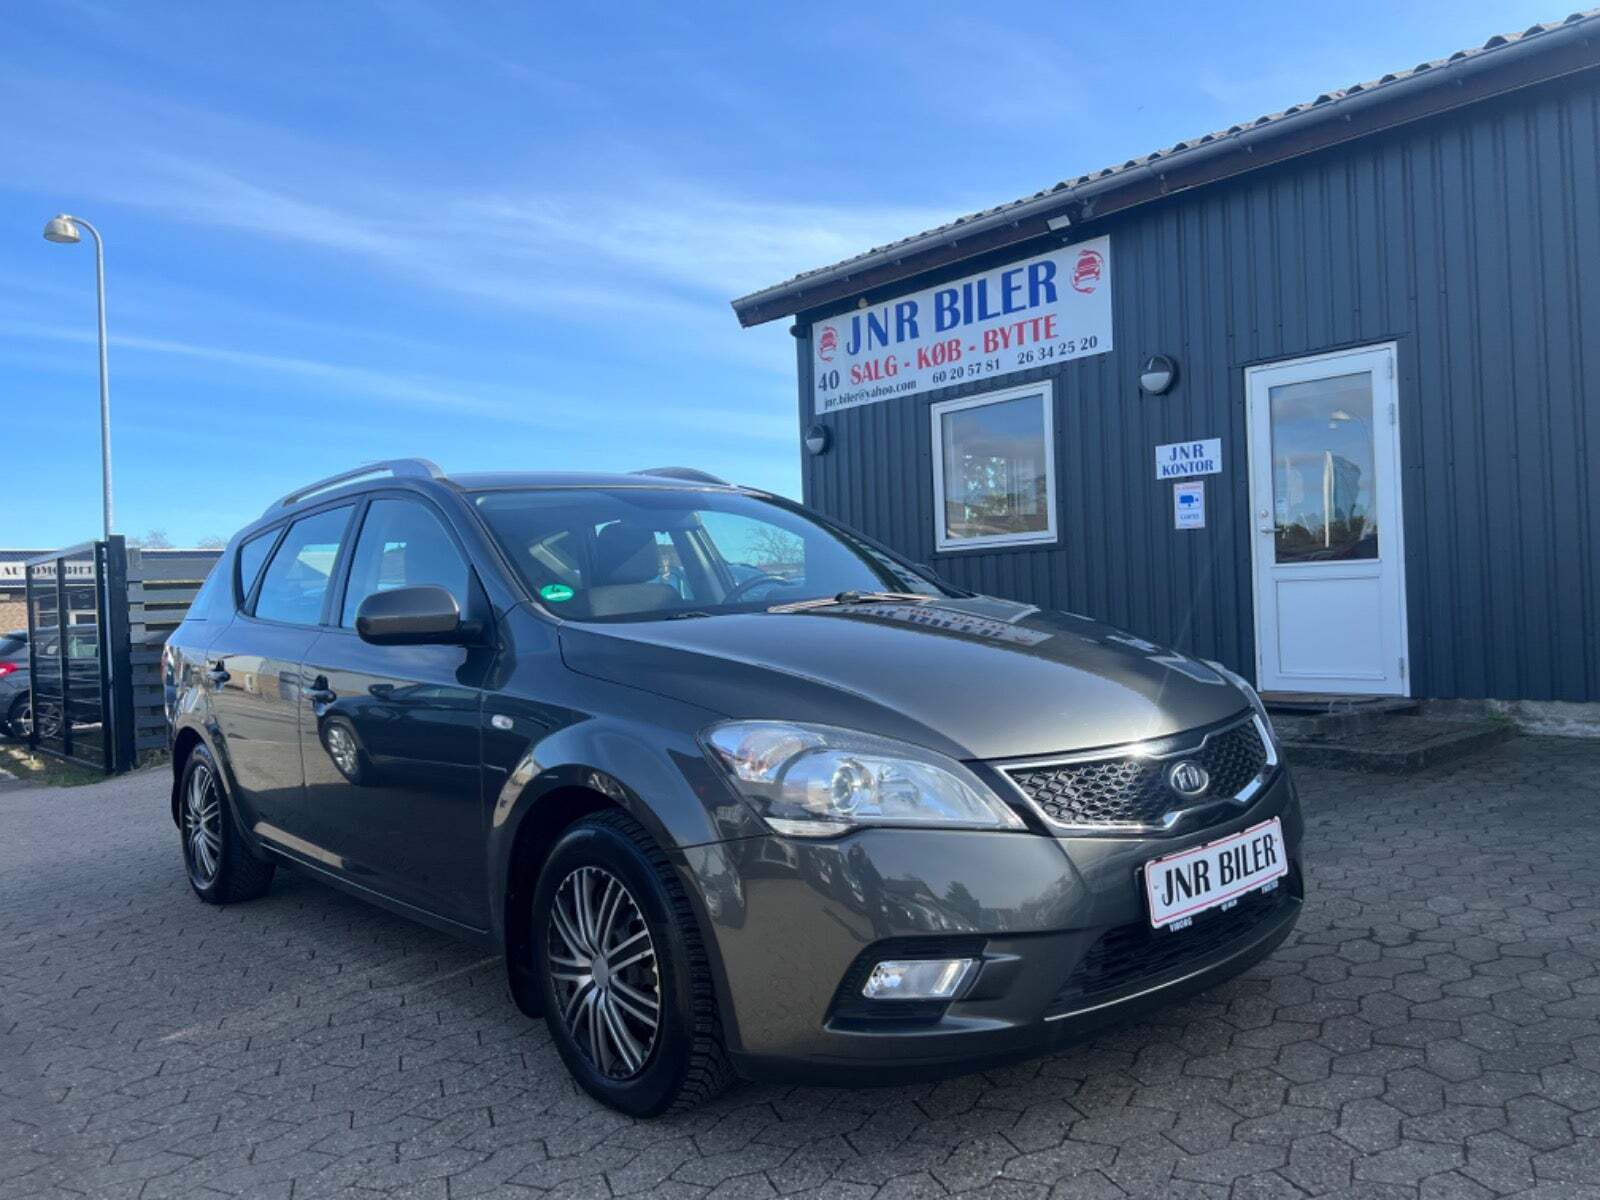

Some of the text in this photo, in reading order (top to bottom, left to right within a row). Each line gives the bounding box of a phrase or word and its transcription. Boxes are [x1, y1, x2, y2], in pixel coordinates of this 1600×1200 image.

[846, 260, 1058, 356] JNR BILER
[850, 354, 898, 385] SALG
[917, 338, 962, 370] KØB
[983, 313, 1059, 353] BYTTE
[1017, 335, 1098, 365] 26 34 25 20
[818, 369, 840, 391] 40
[932, 358, 1000, 384] 60 20 57 81
[1169, 443, 1204, 461] JNR
[1162, 459, 1214, 476] KONTOR
[1161, 833, 1277, 907] JNR BILER
